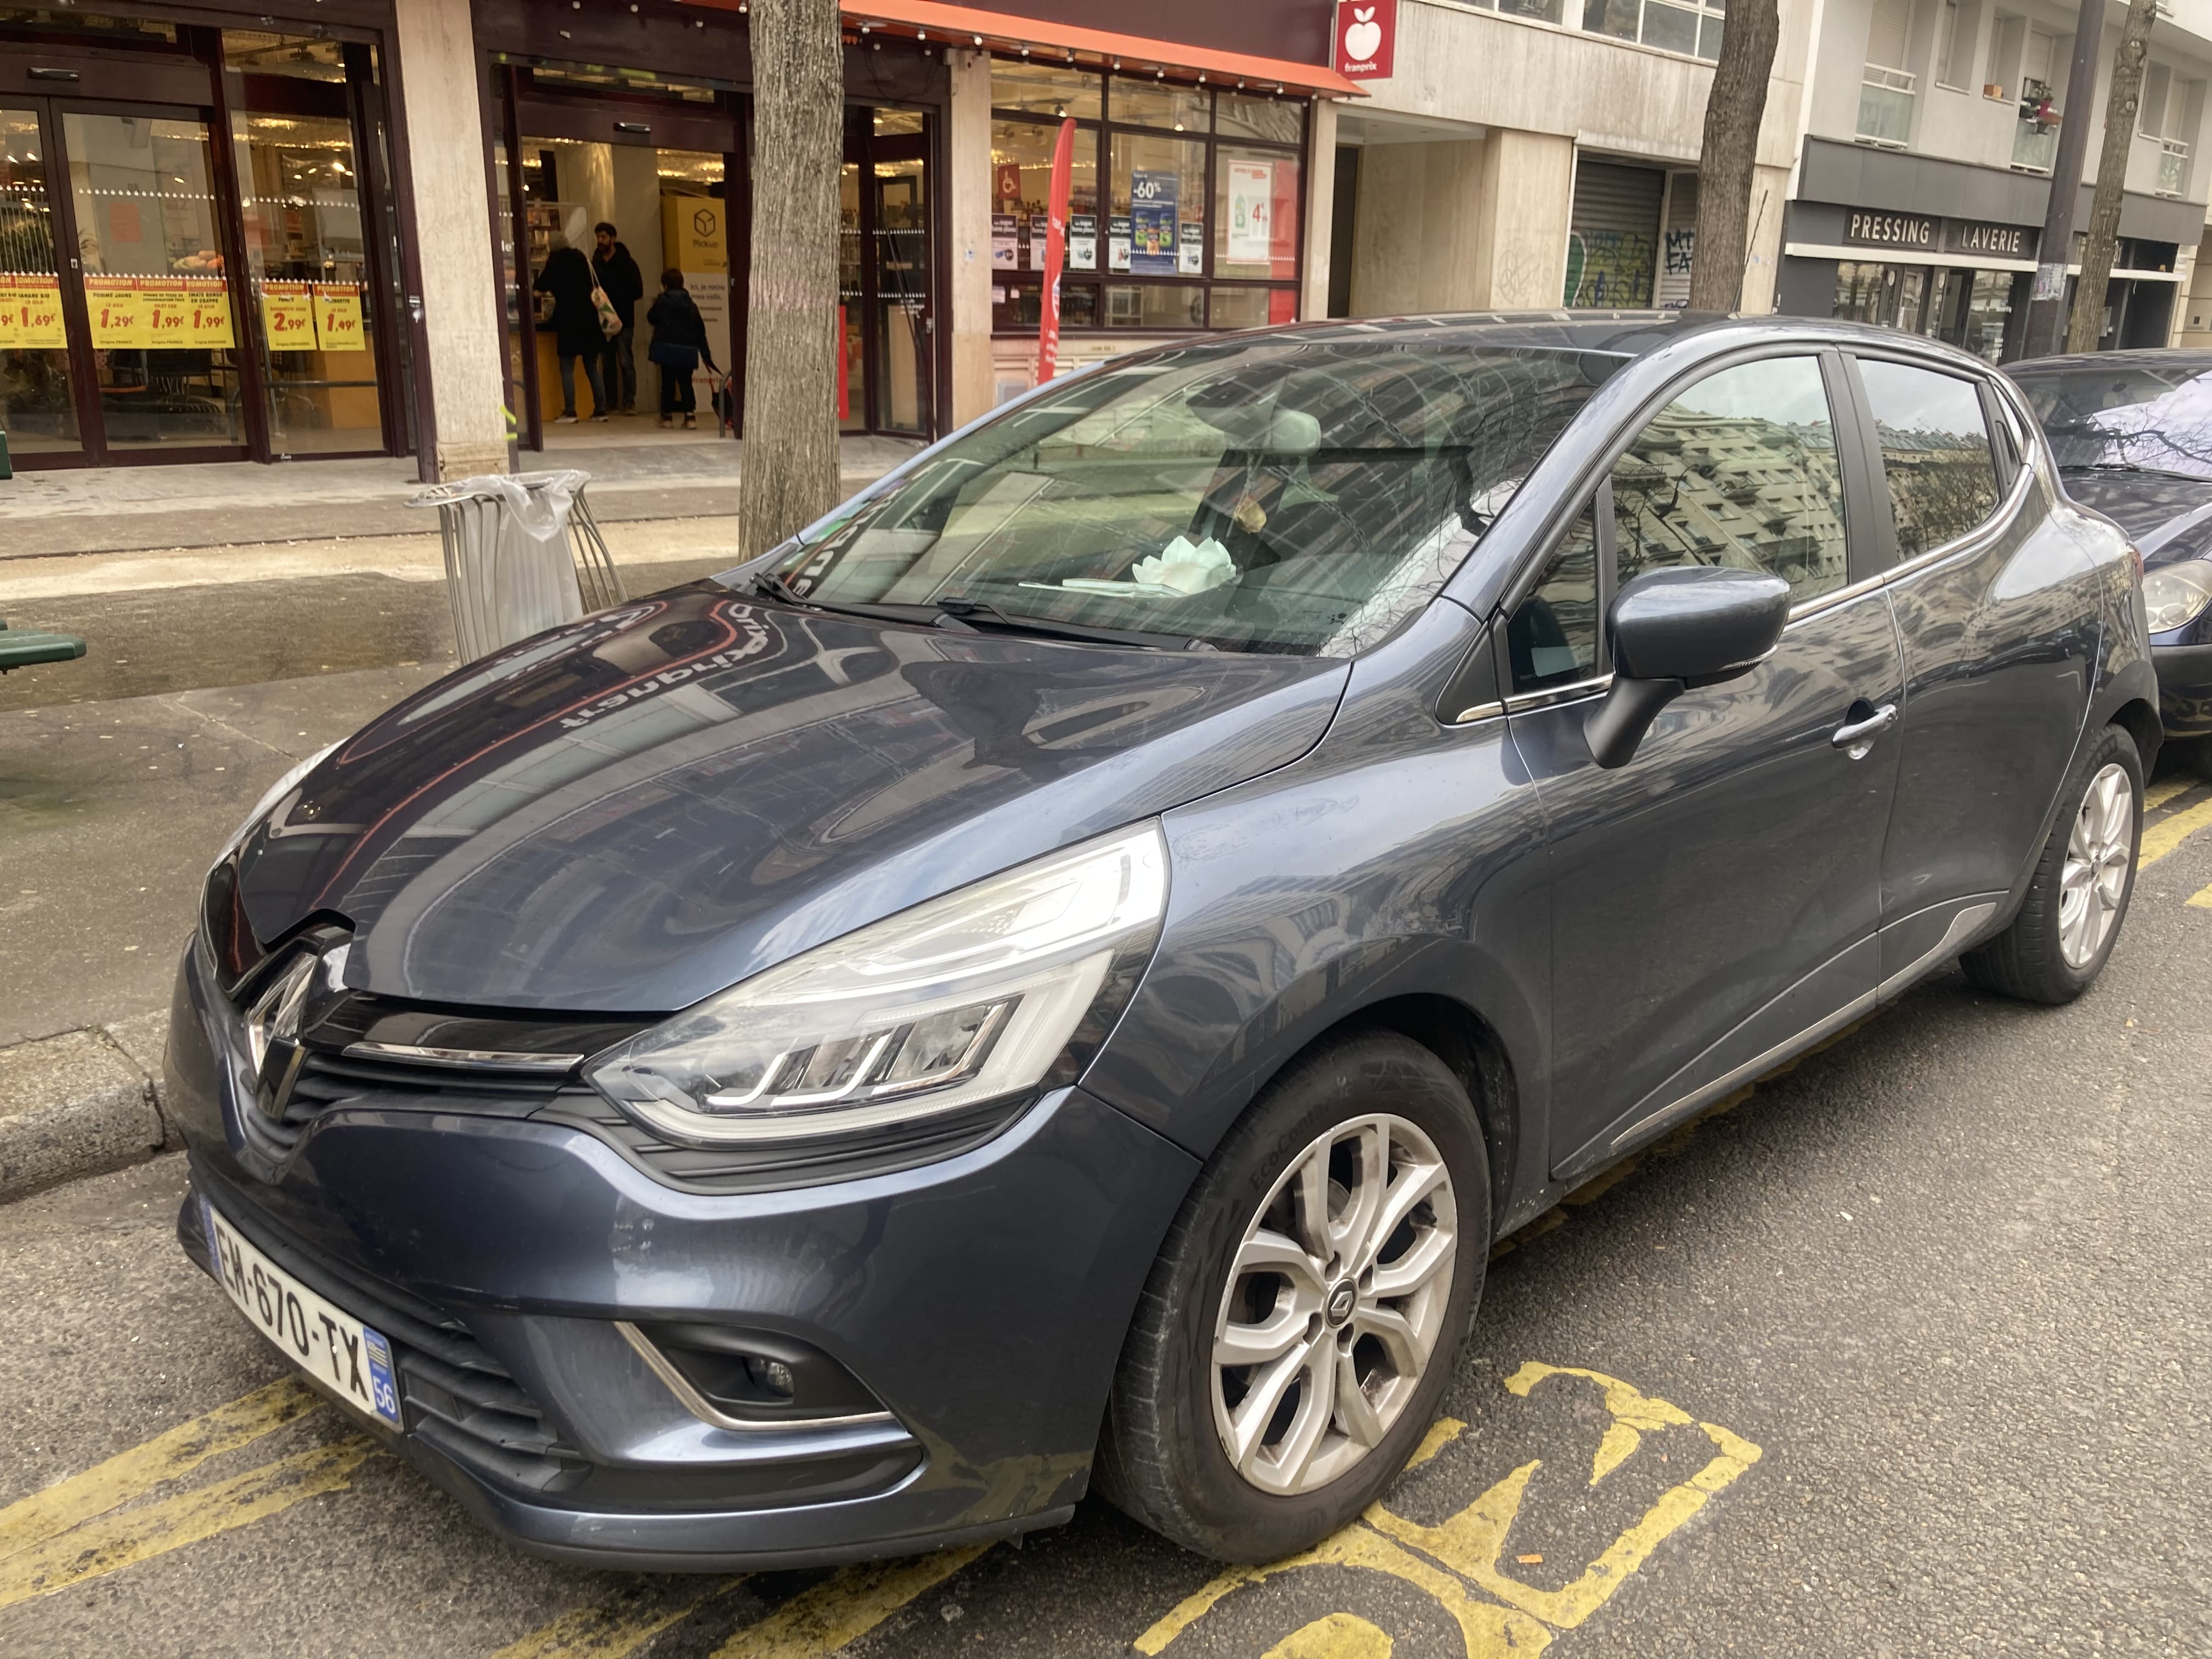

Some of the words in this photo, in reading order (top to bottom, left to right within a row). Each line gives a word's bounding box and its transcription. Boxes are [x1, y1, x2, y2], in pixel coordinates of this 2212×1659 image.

[1345, 61, 1378, 73] franprix
[1133, 182, 1161, 199] -60%
[1850, 213, 1930, 244] PRESSING
[1961, 225, 2021, 252] LAVERIE
[264, 284, 304, 292] PROMOTION
[21, 307, 55, 328] 1,69€
[101, 308, 134, 329] 1,29€
[152, 309, 185, 329] 1,99€
[193, 309, 225, 329] 1,99€
[273, 312, 306, 332] 2,99€
[327, 313, 356, 332] 1,49€
[373, 1375, 396, 1414] 56
